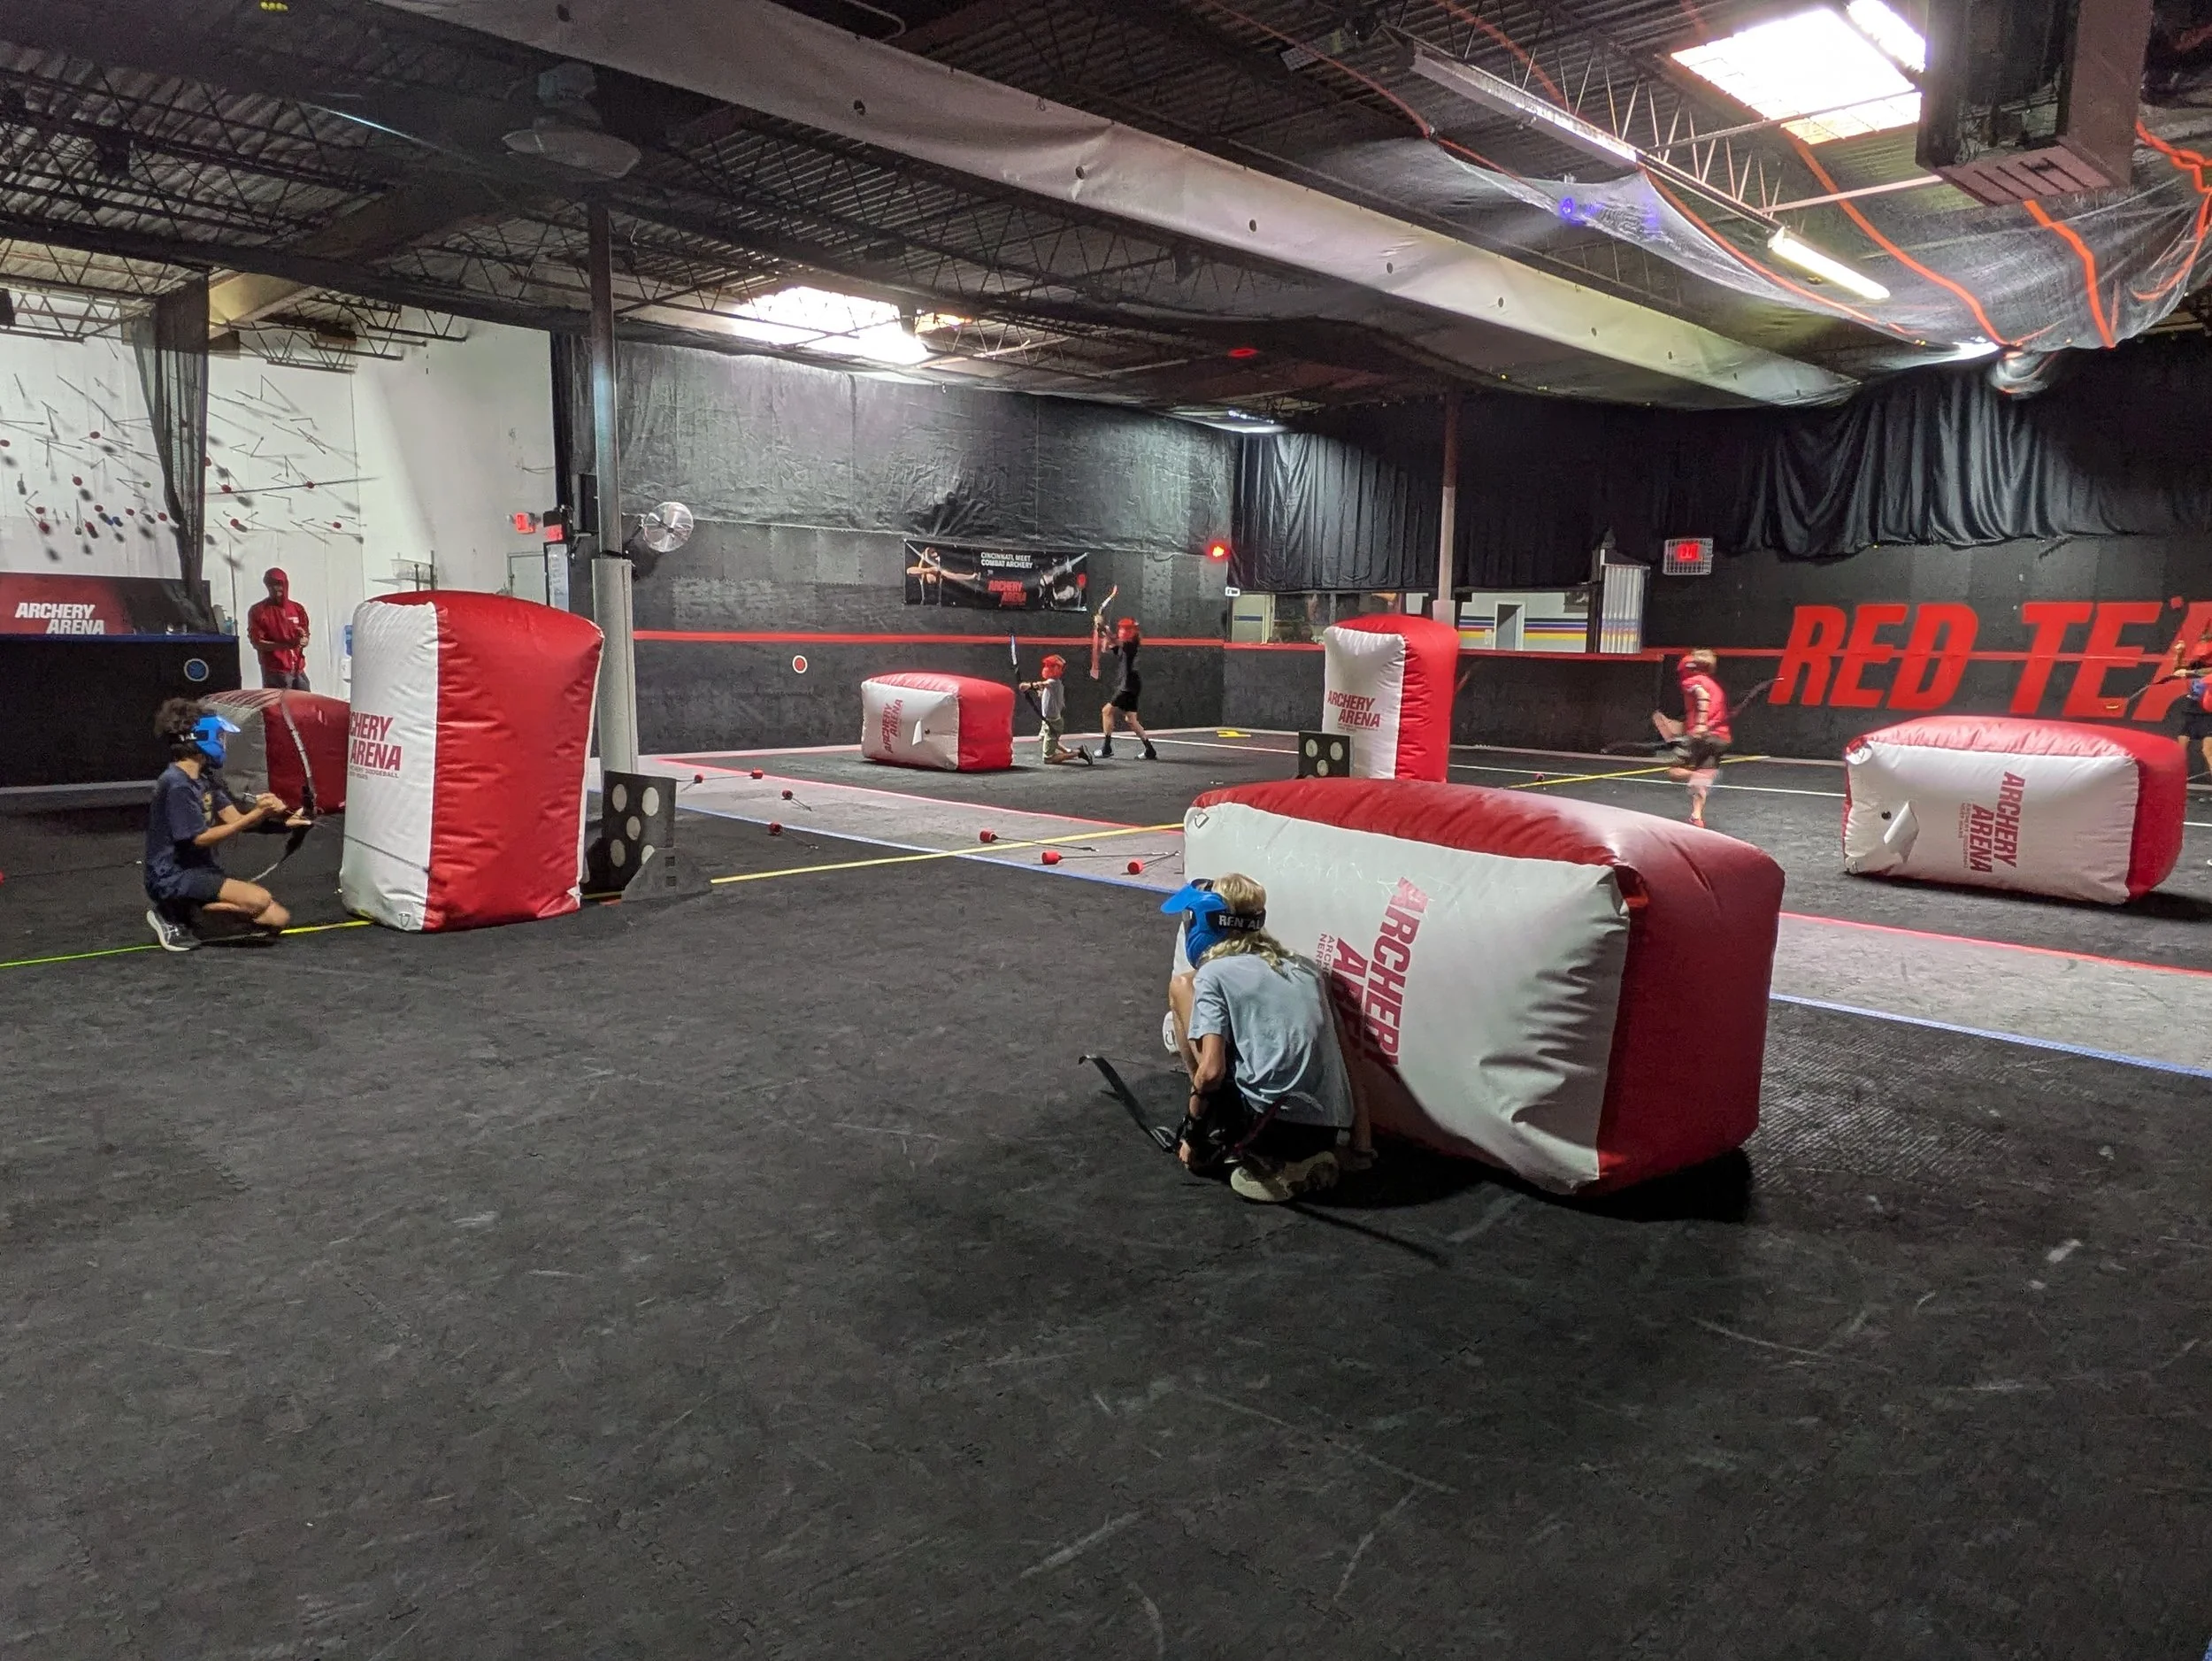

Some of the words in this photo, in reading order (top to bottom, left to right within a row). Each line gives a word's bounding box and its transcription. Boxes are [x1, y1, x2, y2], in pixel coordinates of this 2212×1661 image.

[981, 552, 1014, 561] CINCINNATI,
[988, 580, 1023, 592] ARCHERY
[14, 603, 96, 619] ARCHERY
[45, 619, 105, 634] ARENA
[1768, 604, 1978, 711] RED
[1327, 690, 1375, 711] ARCHERY
[349, 711, 393, 742] CHERY
[881, 703, 894, 754] ARCHERY
[889, 699, 903, 737] ARENA
[1338, 709, 1380, 727] ARENA
[349, 740, 402, 771] ARENA
[1993, 771, 2025, 868] ARCHERY
[1970, 804, 1994, 873] ARENA
[1218, 914, 1262, 929] RENAL
[1323, 935, 1334, 976] ARCH
